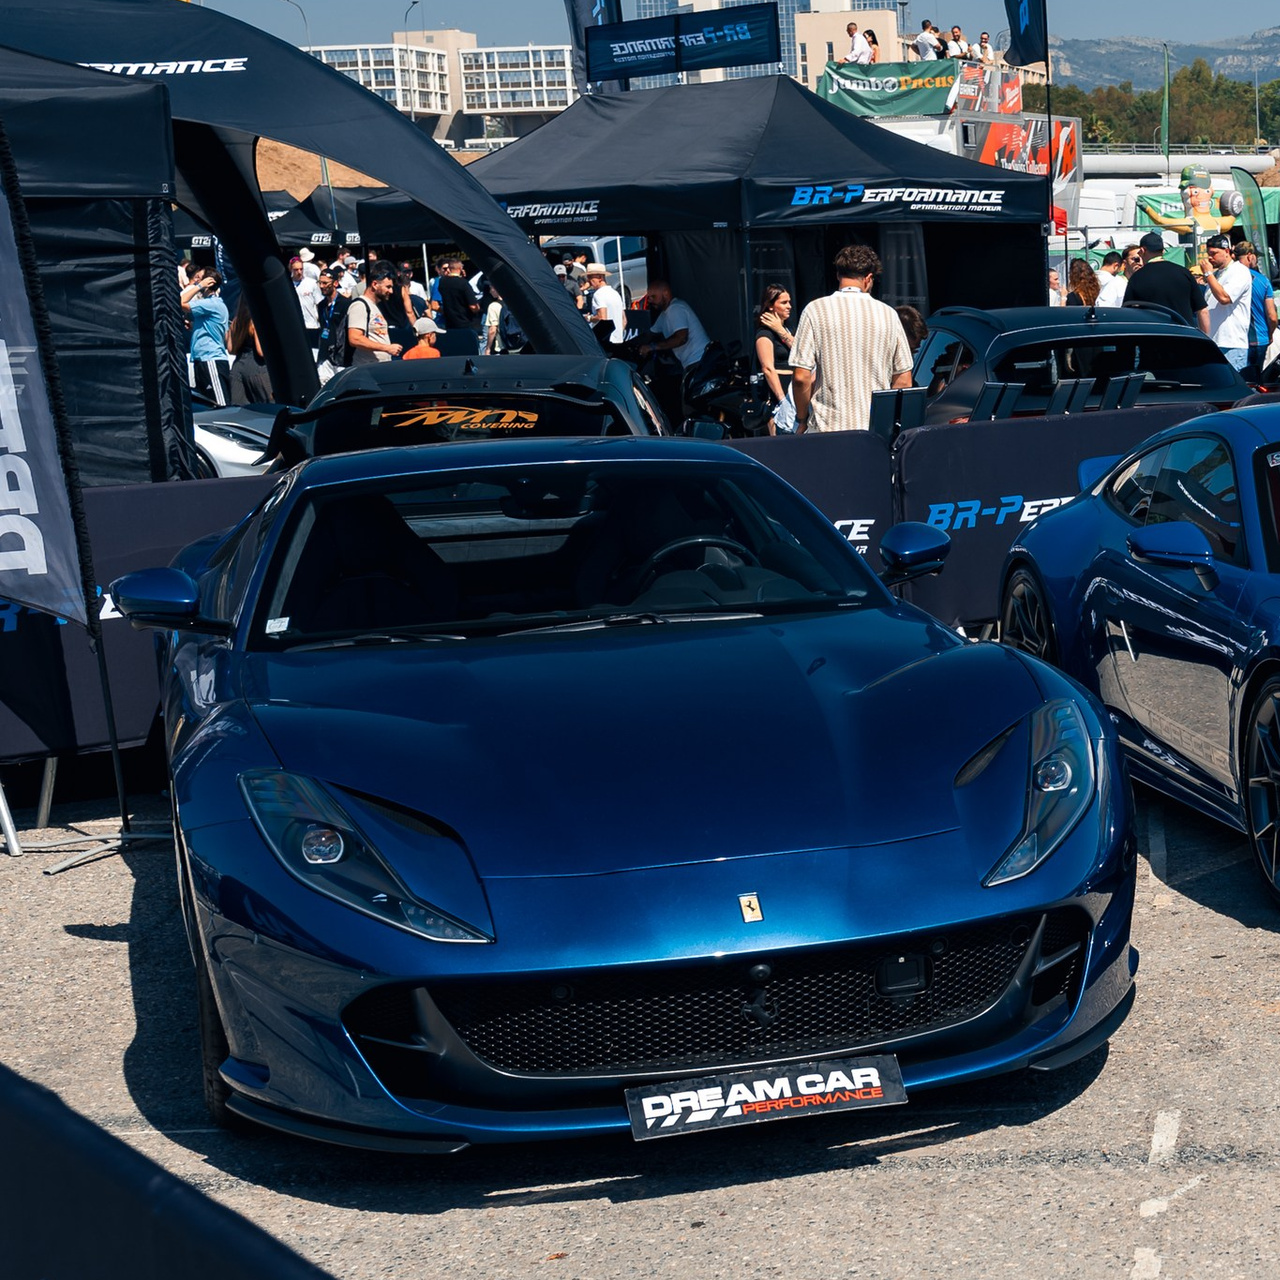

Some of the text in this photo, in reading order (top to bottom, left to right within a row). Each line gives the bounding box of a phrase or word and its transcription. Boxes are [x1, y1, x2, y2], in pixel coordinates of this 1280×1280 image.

[900, 74, 955, 91] Pneus
[911, 204, 966, 212] OPTIMISATION
[641, 1067, 881, 1119] DREAM CAR
[742, 1086, 883, 1115] PERFORMANCE
